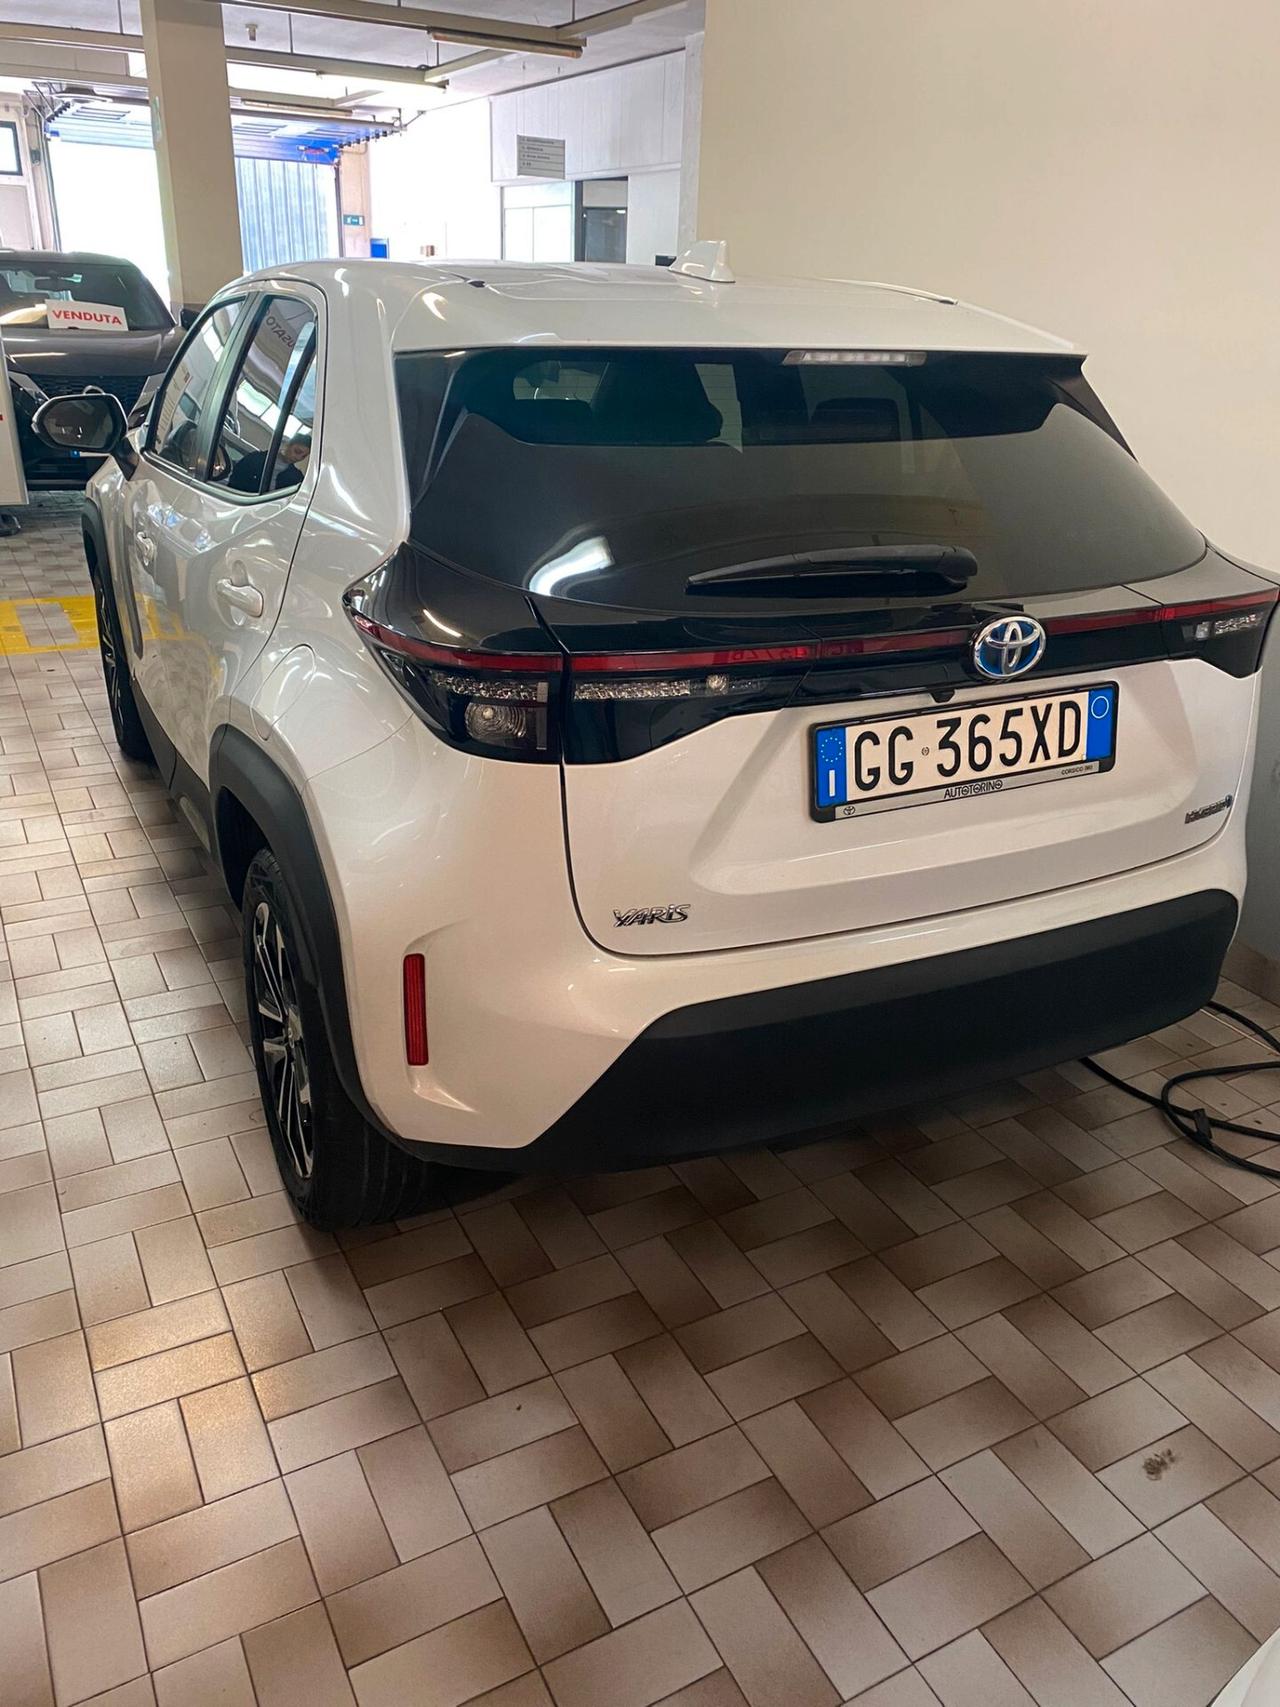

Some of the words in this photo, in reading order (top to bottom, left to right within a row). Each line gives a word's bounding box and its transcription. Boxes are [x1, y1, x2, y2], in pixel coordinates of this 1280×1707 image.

[52, 310, 122, 325] VENDUTA
[854, 725, 914, 791] GG
[936, 700, 1081, 777] 365XD
[944, 779, 1003, 799] AUTOTORINO
